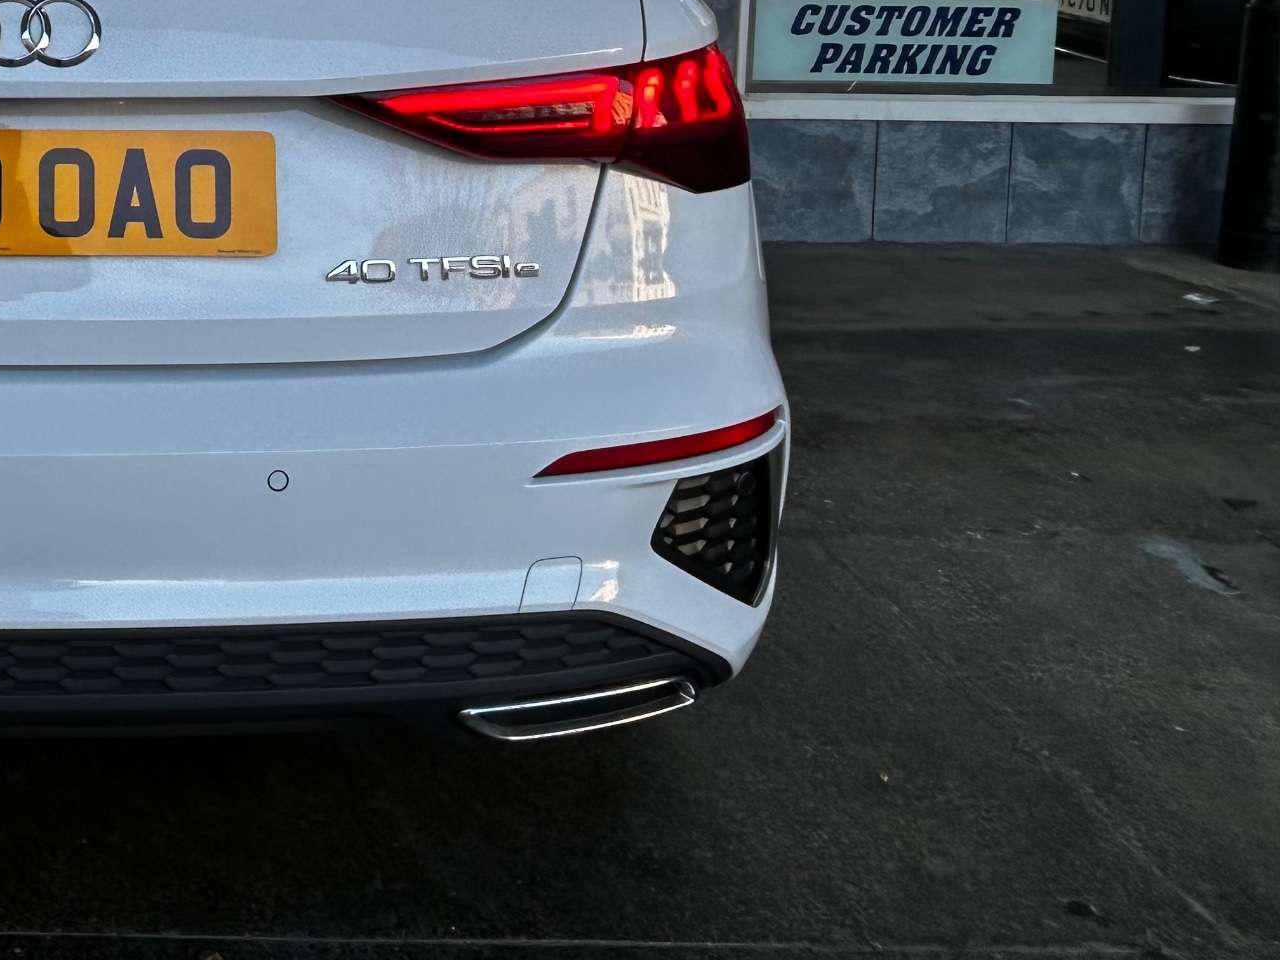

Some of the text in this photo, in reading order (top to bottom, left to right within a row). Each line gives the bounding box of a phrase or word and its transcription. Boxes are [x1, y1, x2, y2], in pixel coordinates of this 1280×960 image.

[790, 3, 1021, 38] CUSTOMER
[809, 42, 998, 76] PARKING
[38, 147, 232, 240] OAO
[325, 259, 397, 284] 40
